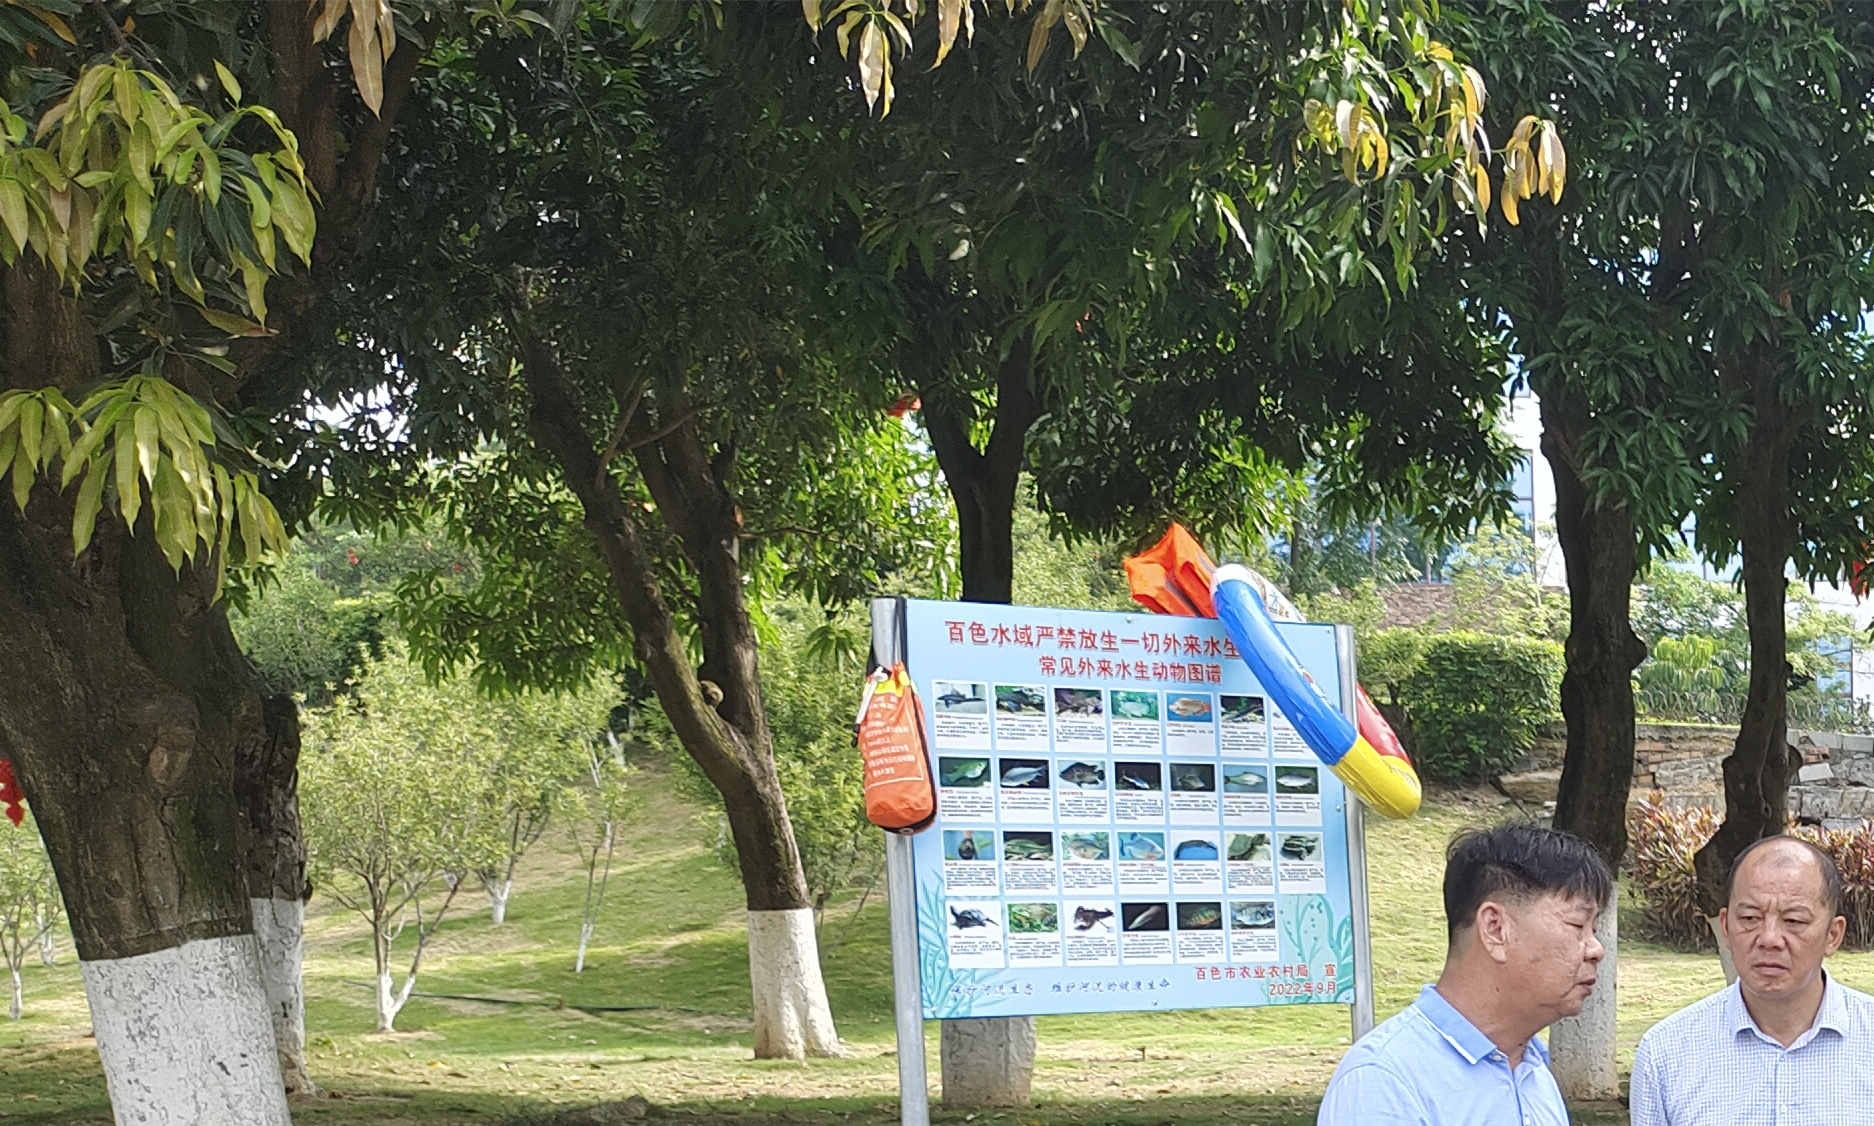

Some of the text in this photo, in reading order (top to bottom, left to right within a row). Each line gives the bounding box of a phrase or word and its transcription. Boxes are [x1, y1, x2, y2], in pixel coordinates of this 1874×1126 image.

[944, 620, 1242, 658] 百色水域严禁放生一切外来水生
[1039, 655, 1222, 684] 常见外来水生动物图谱
[1195, 965, 1308, 980] 百色市农业农村局
[1269, 981, 1336, 996] 2022年9月
